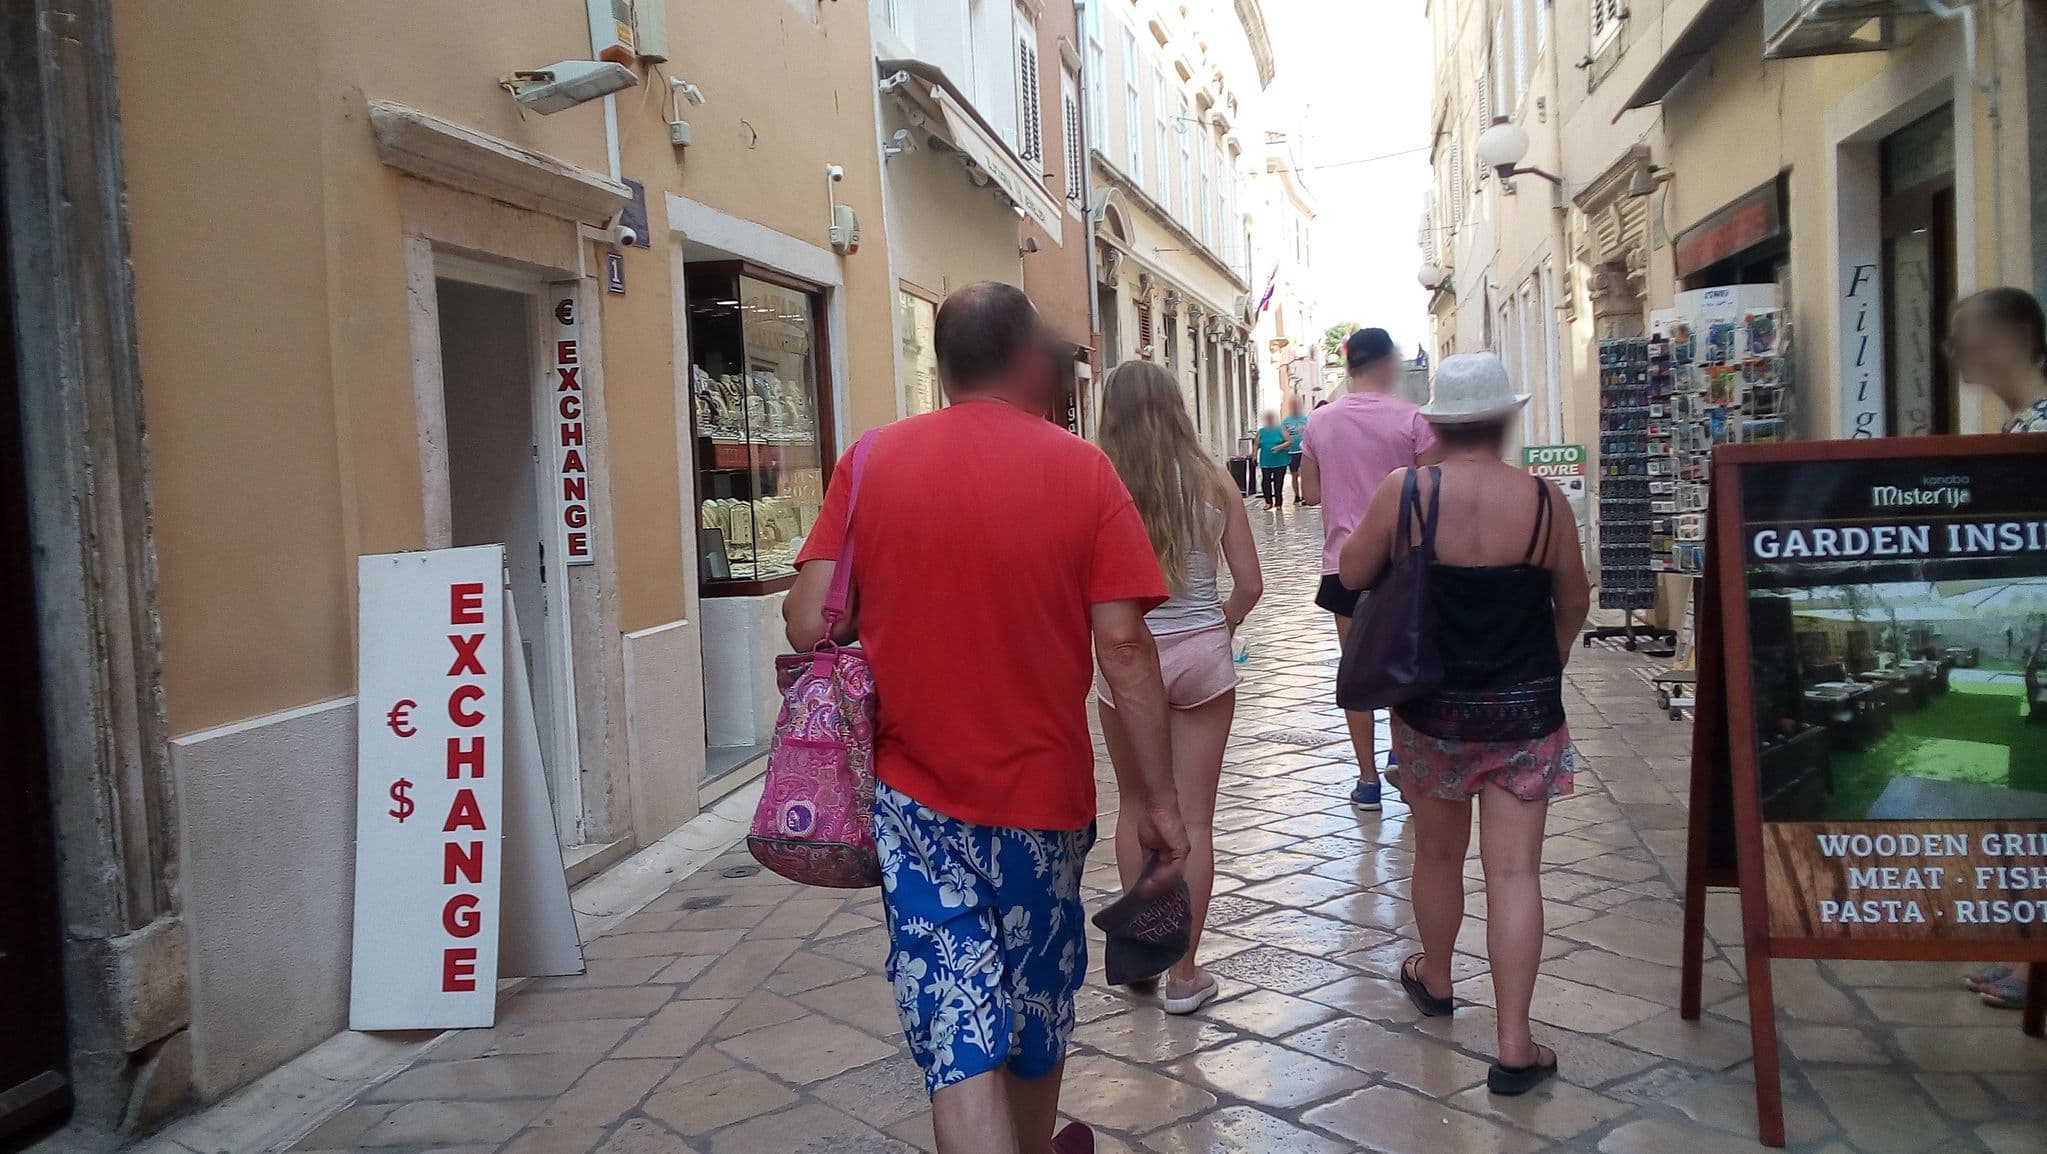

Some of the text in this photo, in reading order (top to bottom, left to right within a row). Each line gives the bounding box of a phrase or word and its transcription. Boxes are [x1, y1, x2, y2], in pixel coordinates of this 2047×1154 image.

[611, 259, 622, 283] 1
[554, 298, 588, 557] € EXCHANGE
[1528, 447, 1579, 463] FOTO
[1528, 464, 1579, 477] LOVRE
[1753, 521, 2047, 559] GARDEN INSI
[387, 699, 418, 738] €
[442, 583, 486, 993] EXCHANGE
[388, 777, 415, 824] $
[1817, 834, 1969, 857] WOODEN
[1849, 866, 2047, 890] MEAT FISH
[1820, 900, 1926, 923] PASTA
